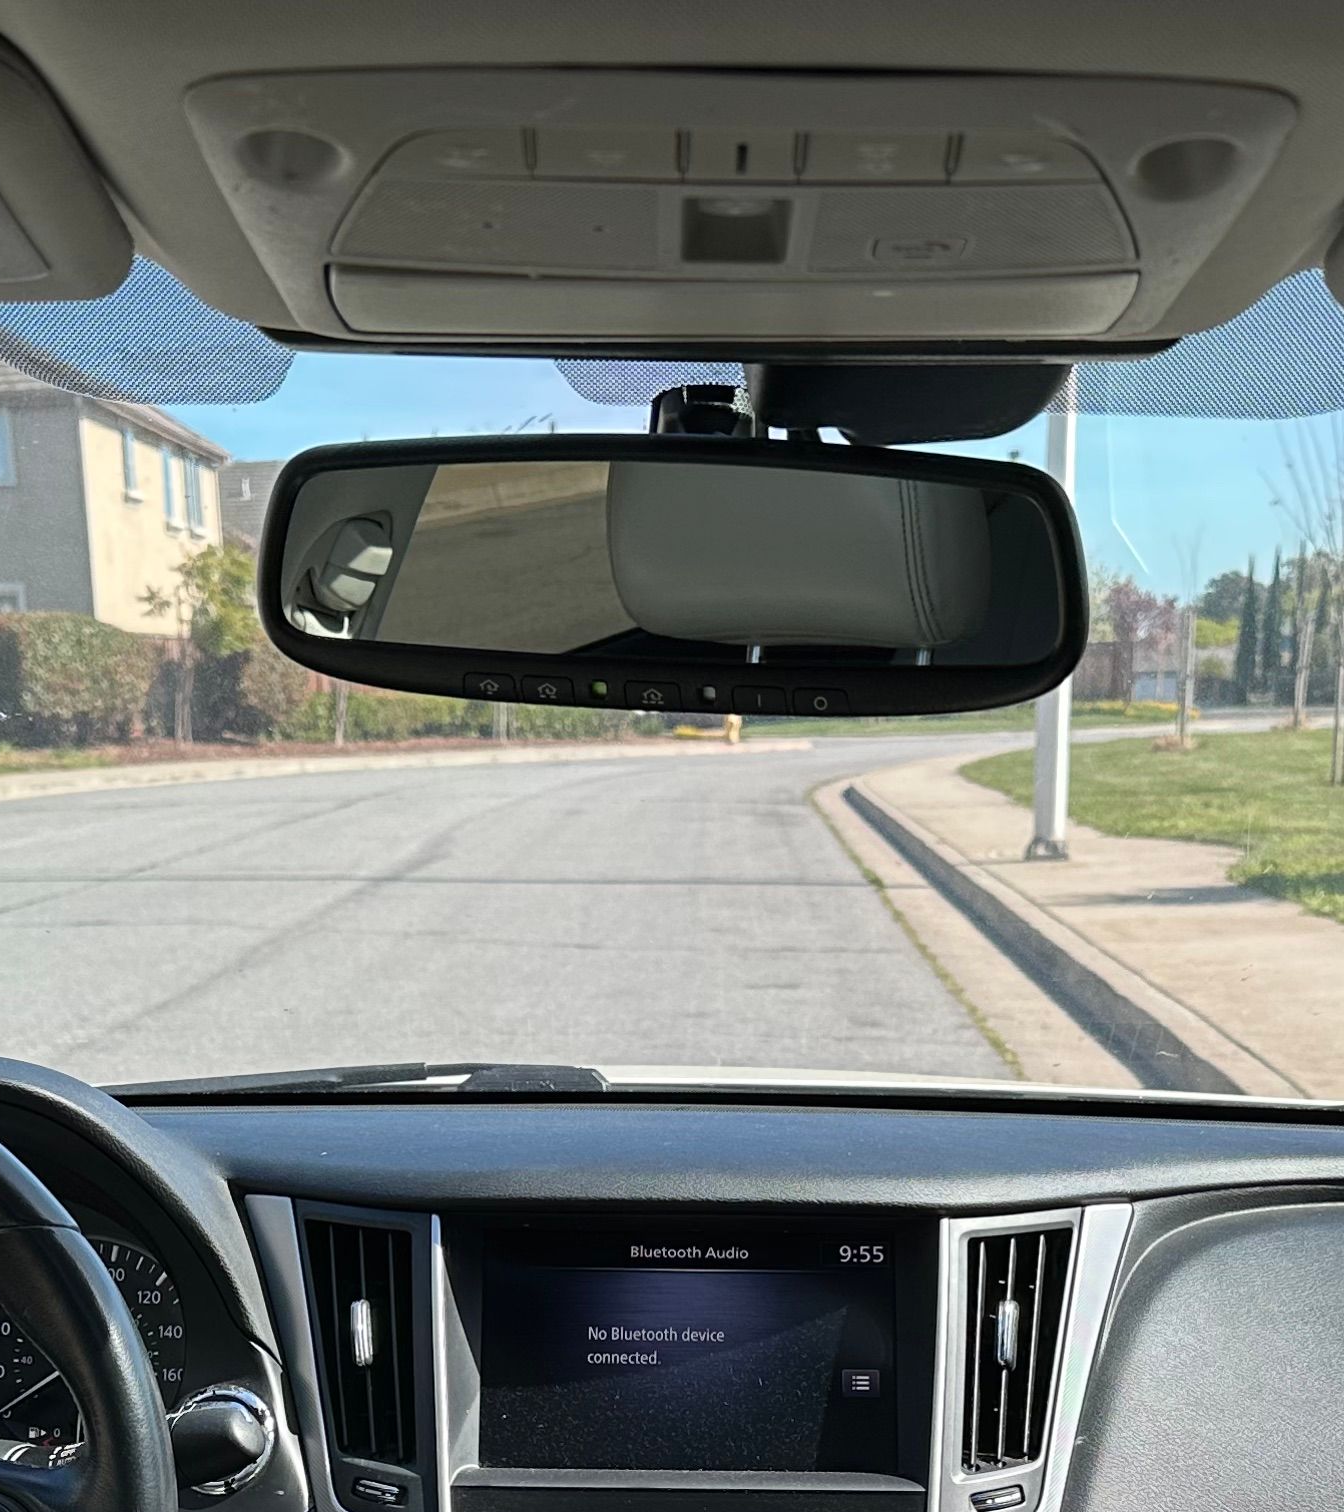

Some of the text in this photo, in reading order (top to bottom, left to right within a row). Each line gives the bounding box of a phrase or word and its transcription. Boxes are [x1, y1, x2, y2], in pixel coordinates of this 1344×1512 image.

[630, 1245, 750, 1261] Bluetooth Audio
[839, 1245, 886, 1264] 9:55
[108, 1268, 126, 1282] 00
[137, 1290, 162, 1305] 120
[158, 1325, 184, 1340] 140
[586, 1325, 726, 1344] No Bluetooth device
[586, 1349, 663, 1367] connected.
